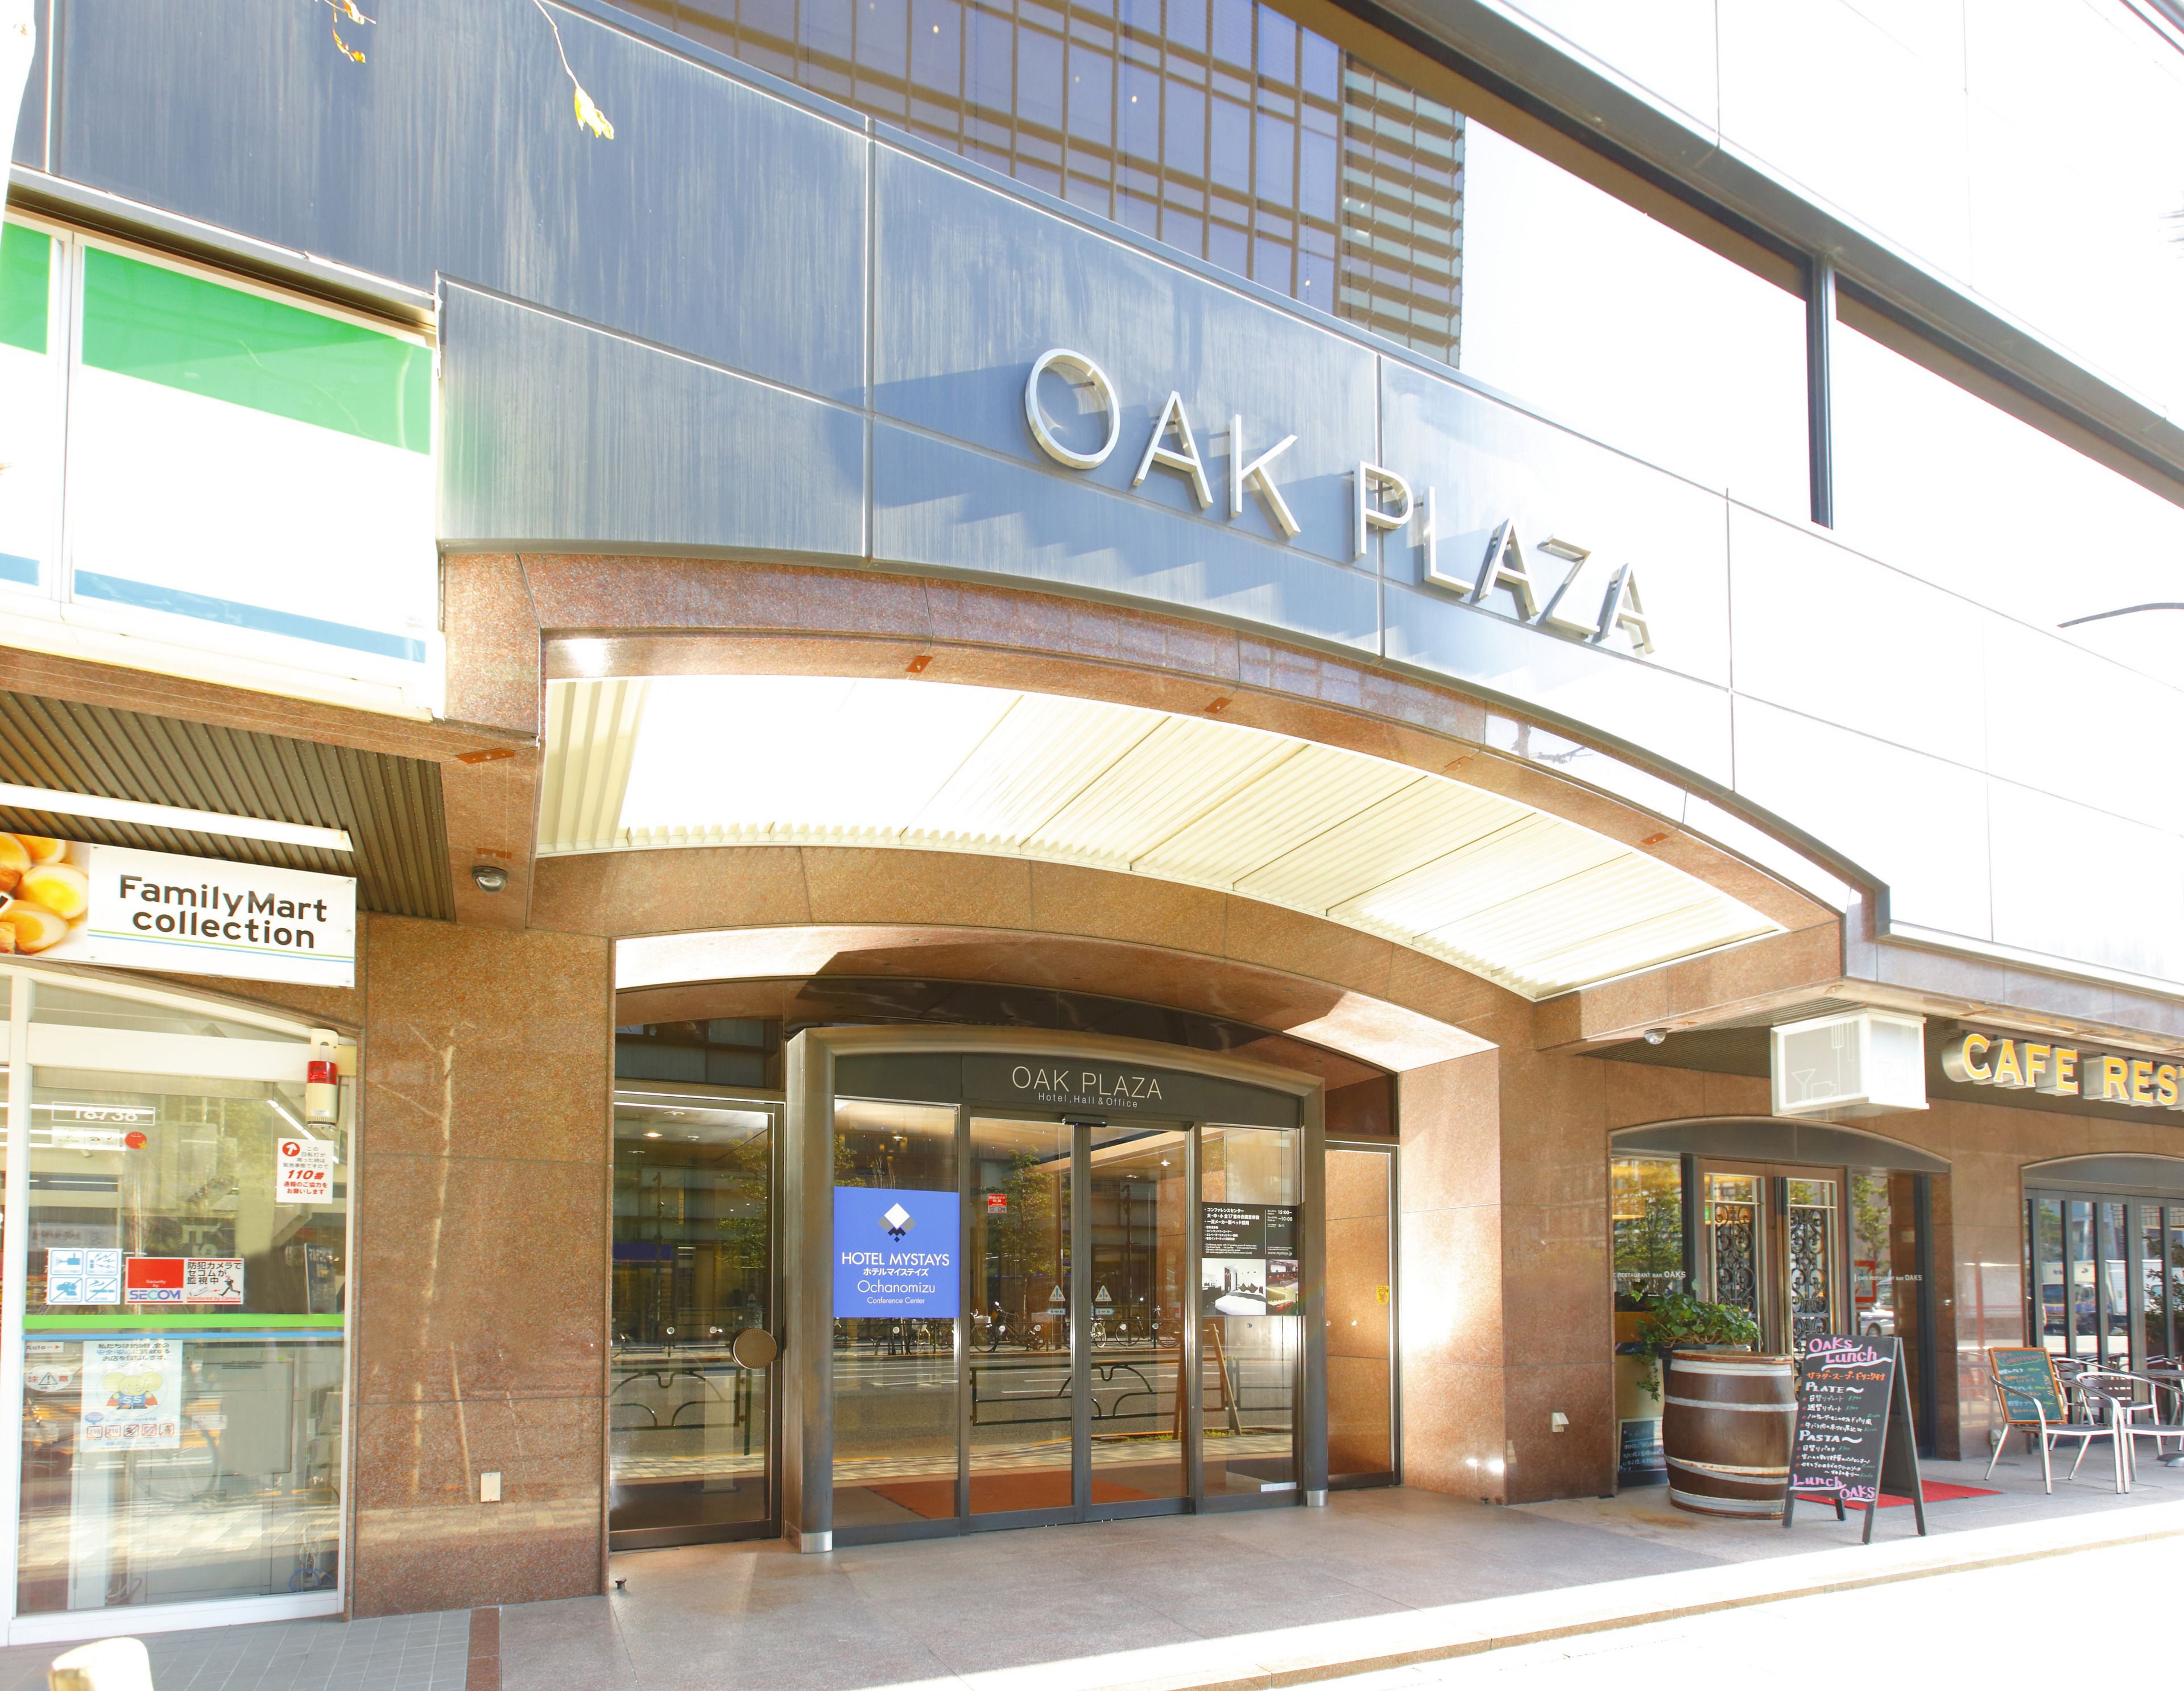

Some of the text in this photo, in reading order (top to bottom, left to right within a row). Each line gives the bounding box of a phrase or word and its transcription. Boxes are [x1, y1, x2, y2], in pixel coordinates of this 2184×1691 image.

[1024, 349, 1656, 657] OAK PLAZA
[120, 874, 327, 922] FamilyMart
[133, 910, 315, 949] collection
[1962, 1033, 2184, 1105] CAFE RES
[1012, 1066, 1163, 1100] OAK PLAZA
[288, 1170, 324, 1180] 110番
[842, 1252, 950, 1266] HOTEL MYSTAYS
[863, 1267, 929, 1276] ホテルマイステイズ
[857, 1279, 936, 1293] Ochanomizu
[130, 1290, 181, 1300] SECOM
[1825, 1346, 1878, 1363] Lunch
[1793, 1473, 1843, 1487] Lunch
